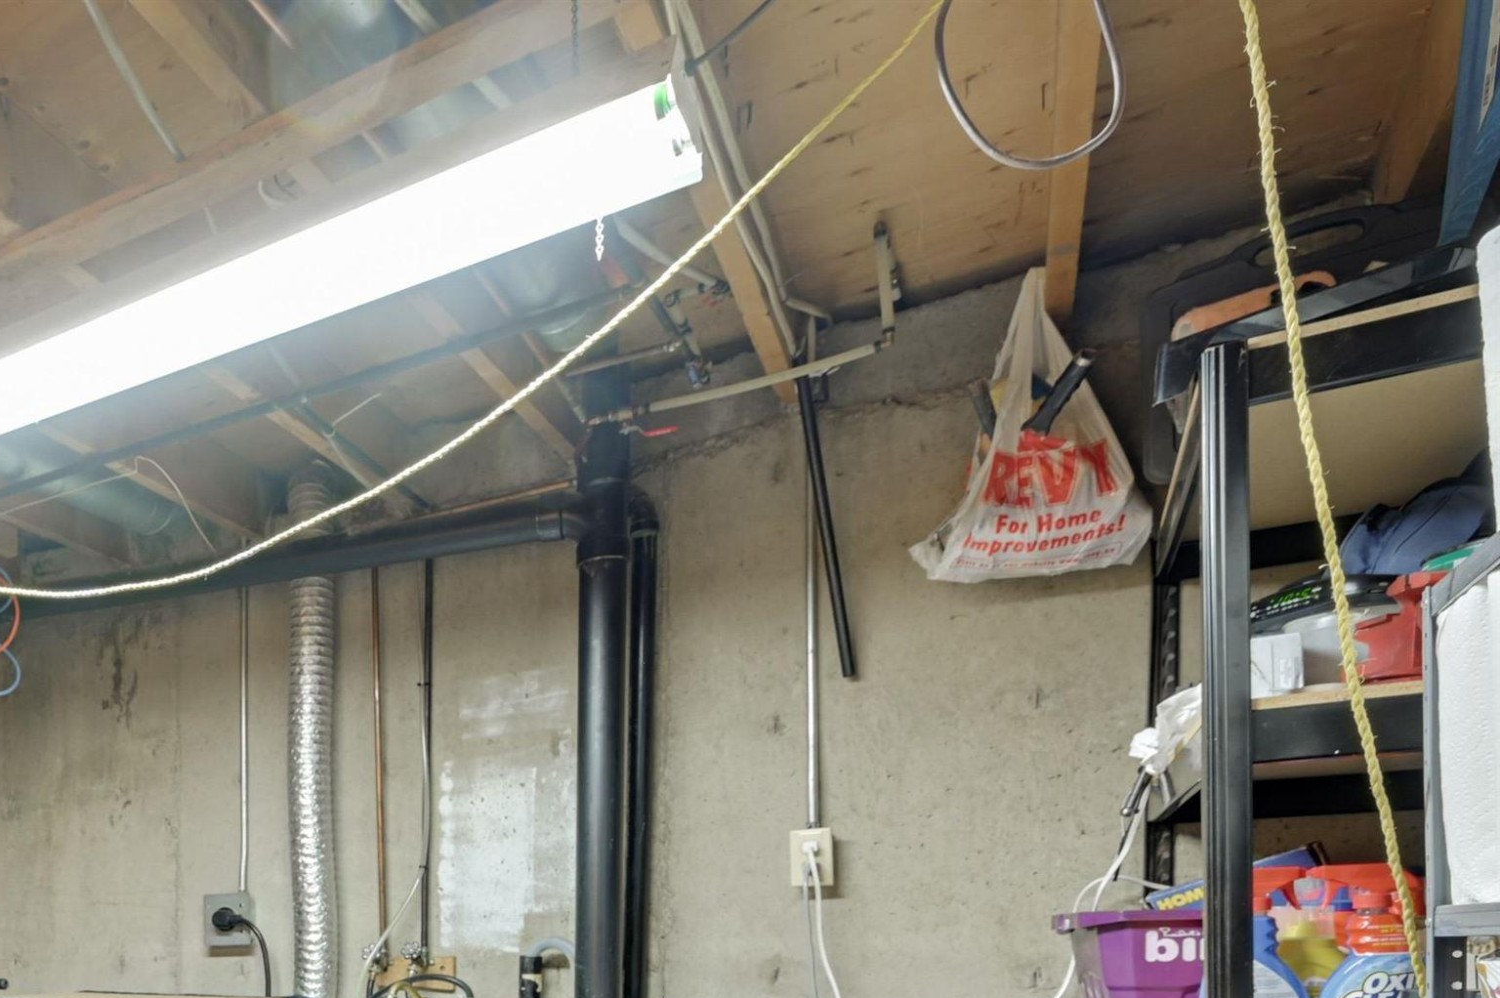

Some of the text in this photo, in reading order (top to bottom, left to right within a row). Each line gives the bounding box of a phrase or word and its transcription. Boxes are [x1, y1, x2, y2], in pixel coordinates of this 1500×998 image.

[981, 438, 1118, 509] REVY
[963, 514, 1127, 557] Improvements!
[995, 509, 1102, 535] For Home
[1155, 886, 1205, 910] HOM
[1145, 930, 1205, 962] bi
[1362, 971, 1415, 994] OXI
